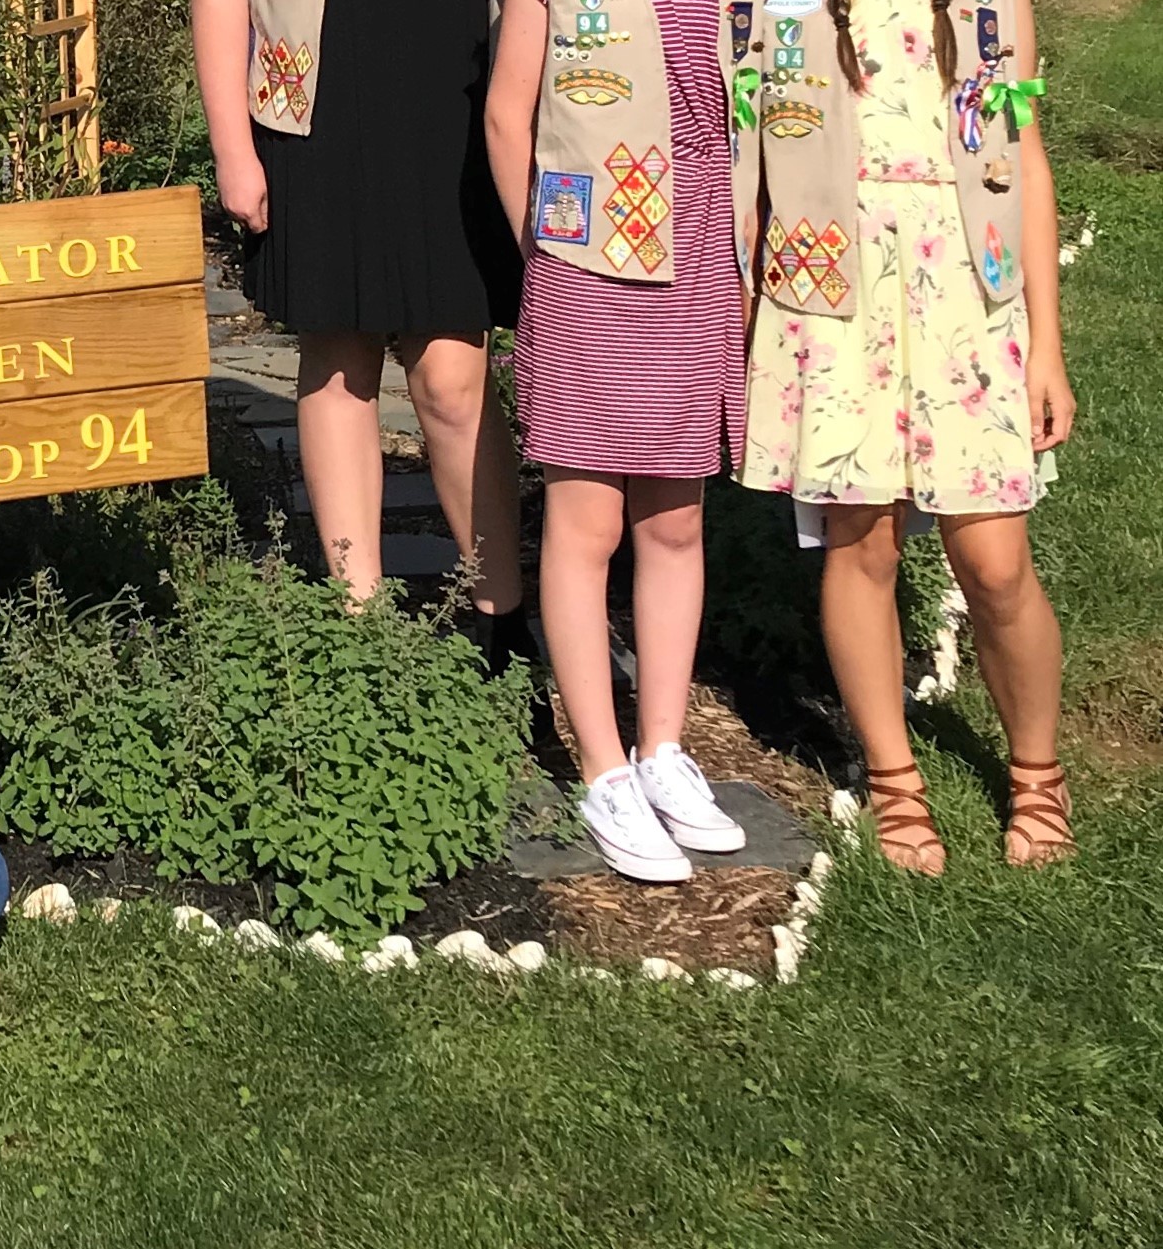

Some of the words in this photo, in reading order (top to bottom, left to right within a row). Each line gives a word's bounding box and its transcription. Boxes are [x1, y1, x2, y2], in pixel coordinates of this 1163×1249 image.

[579, 14, 607, 31] 94
[777, 50, 803, 66] 94
[80, 408, 153, 470] 94
